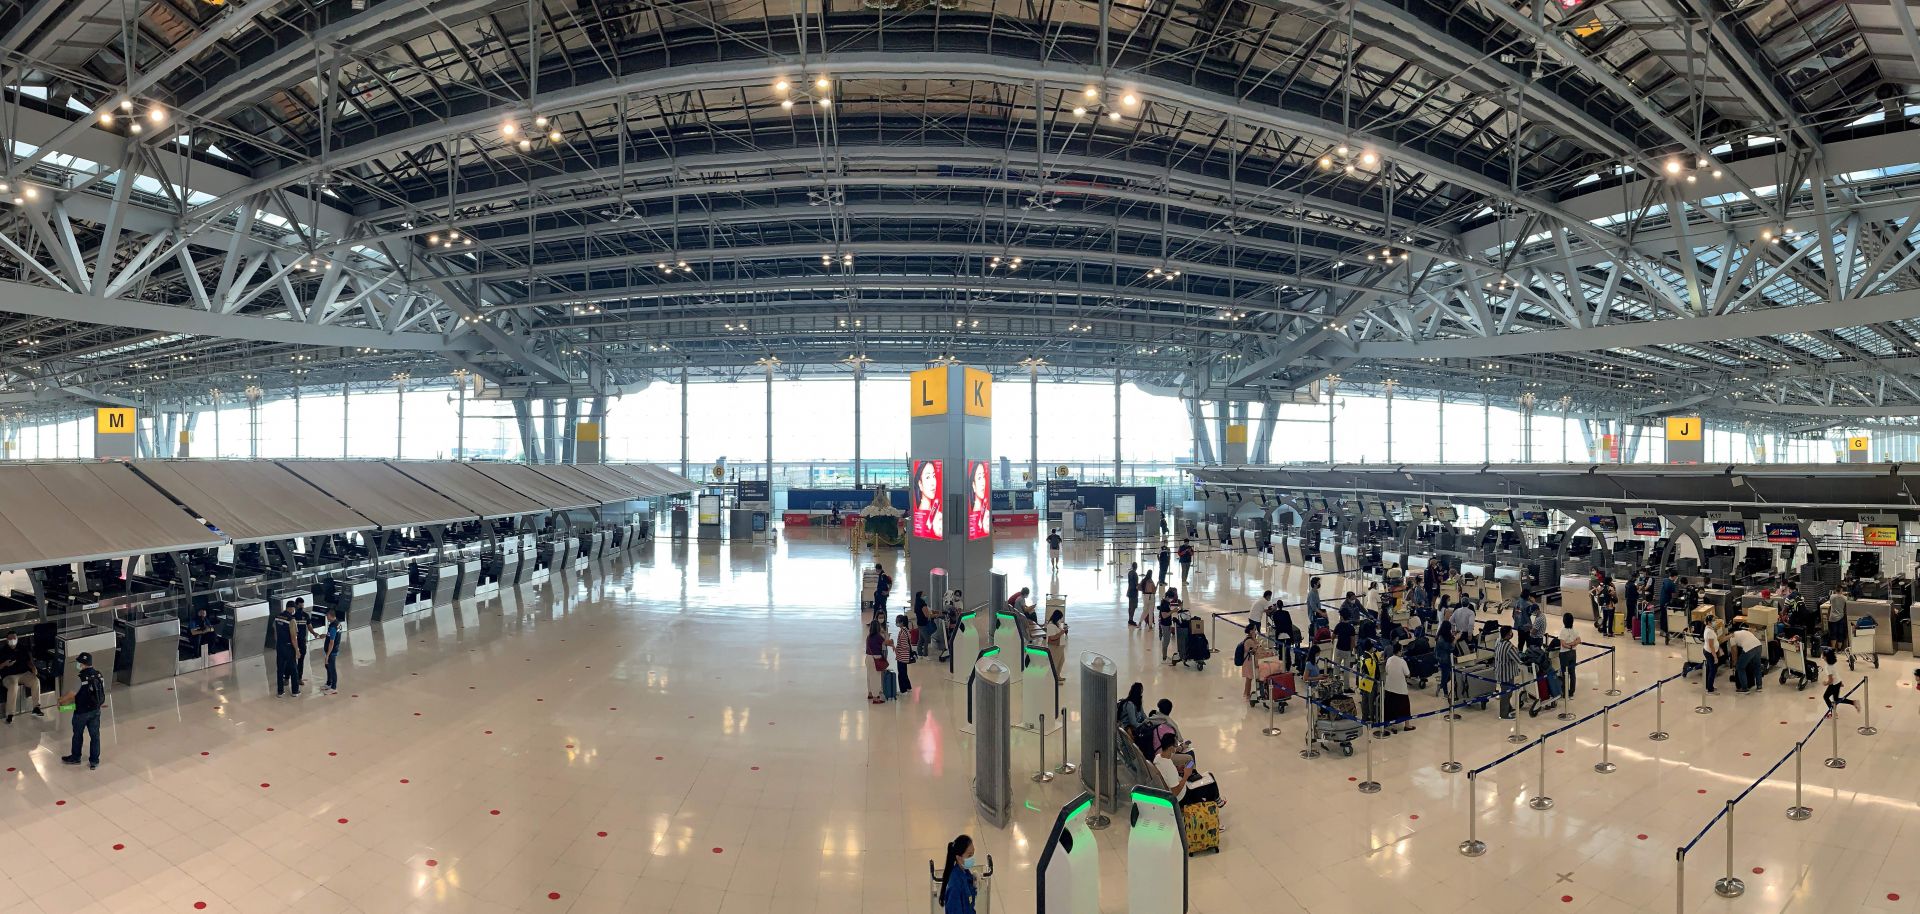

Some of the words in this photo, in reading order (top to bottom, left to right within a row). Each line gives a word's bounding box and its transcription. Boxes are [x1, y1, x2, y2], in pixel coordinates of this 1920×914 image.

[923, 380, 933, 406] L
[975, 380, 984, 407] K
[109, 413, 124, 428] M
[1680, 422, 1689, 436] J
[1854, 439, 1862, 448] G
